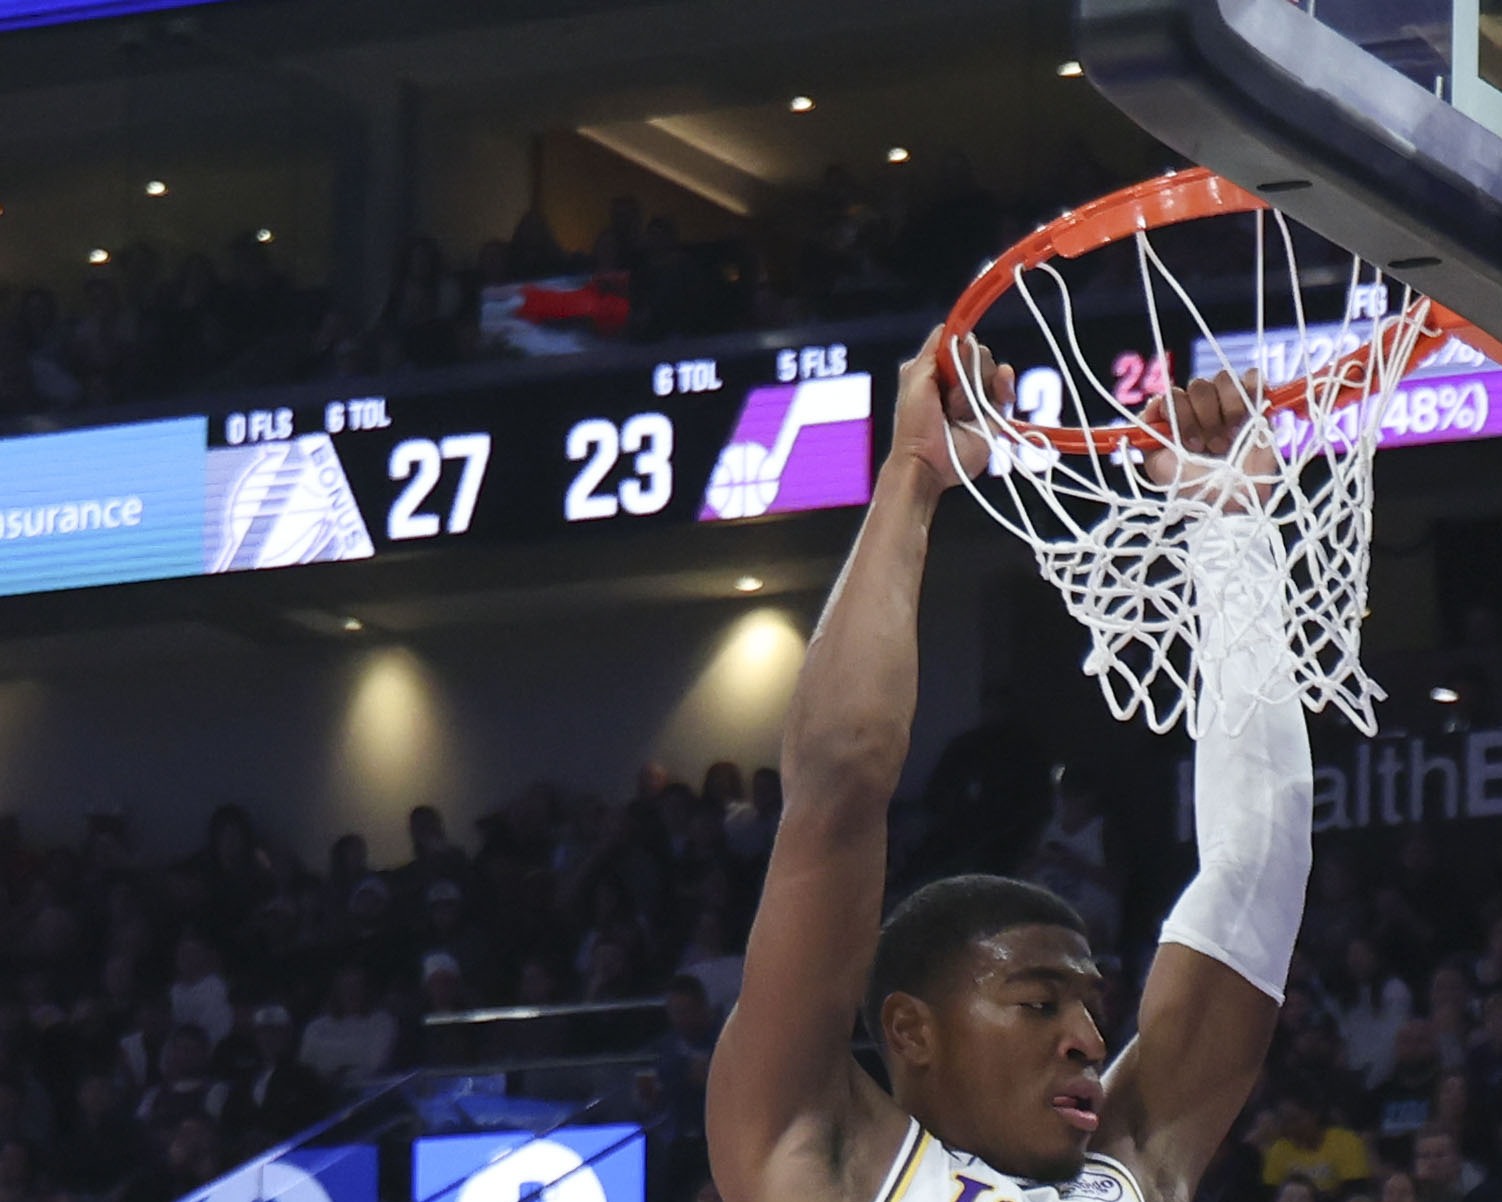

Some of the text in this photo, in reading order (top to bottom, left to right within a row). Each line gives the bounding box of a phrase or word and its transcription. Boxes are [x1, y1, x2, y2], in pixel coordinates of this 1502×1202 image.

[802, 344, 848, 378] FLS
[250, 408, 294, 442] FLS
[387, 434, 491, 540] 27
[565, 413, 673, 521] 23
